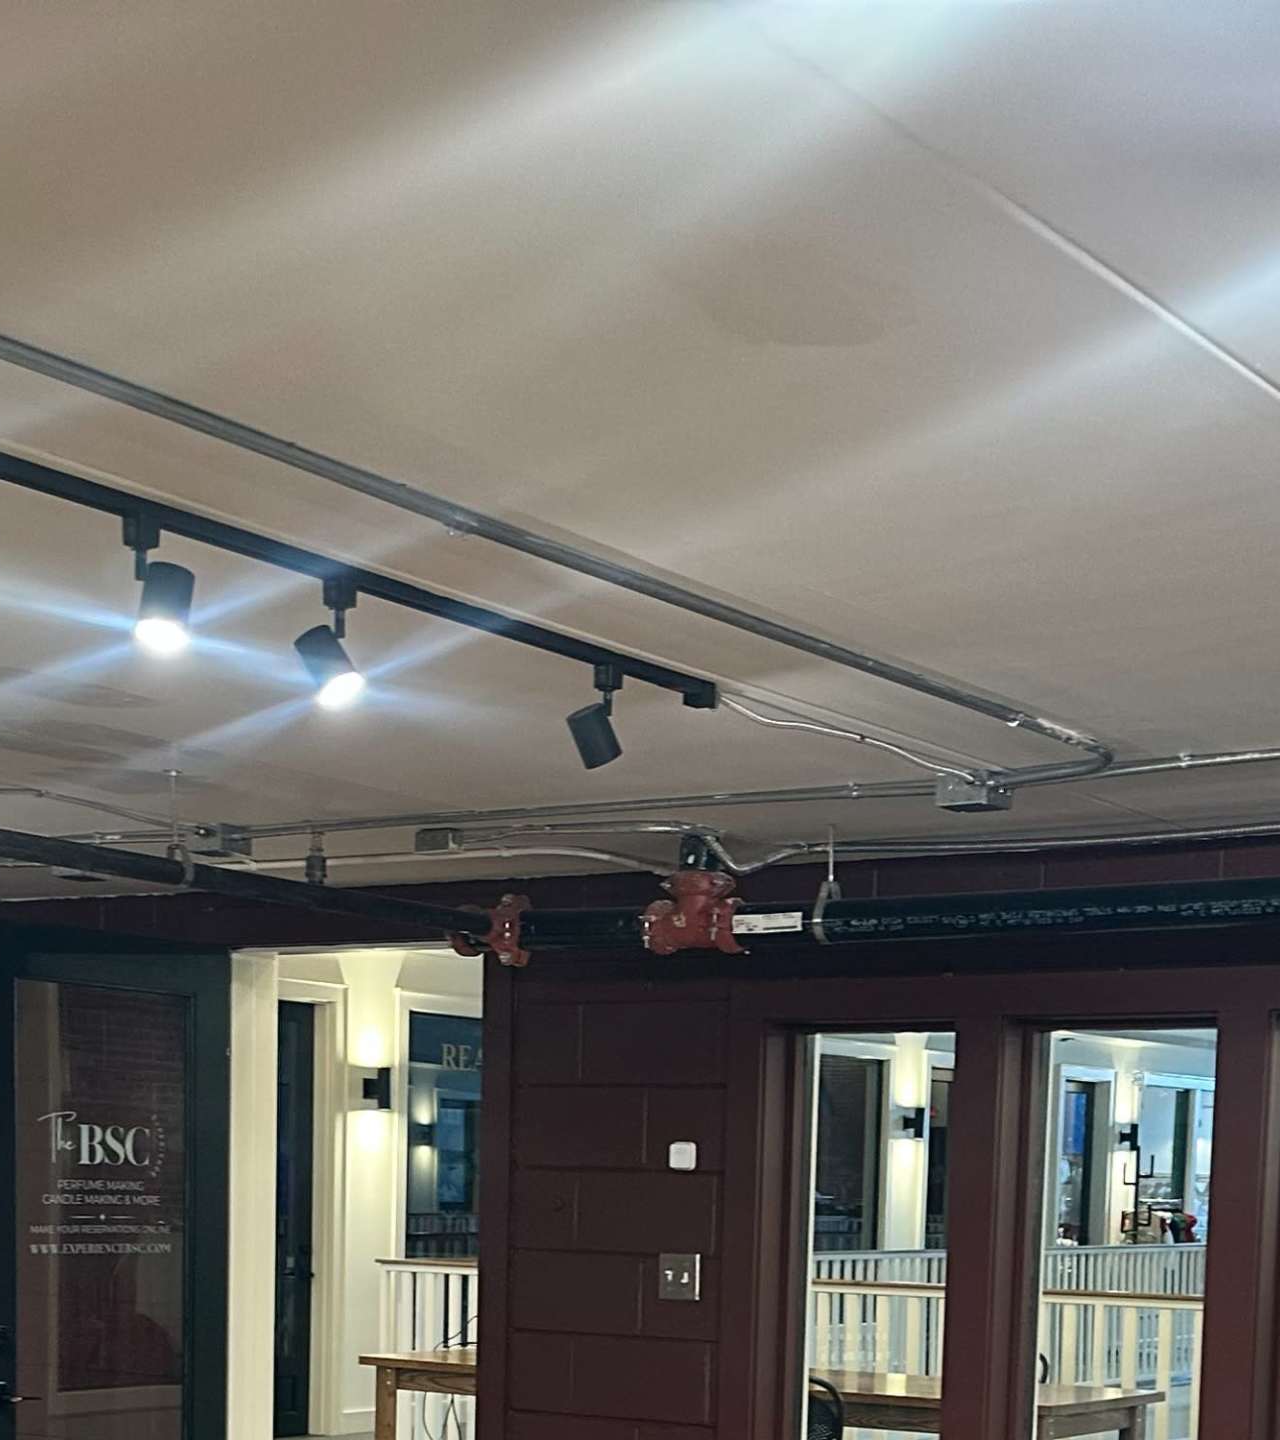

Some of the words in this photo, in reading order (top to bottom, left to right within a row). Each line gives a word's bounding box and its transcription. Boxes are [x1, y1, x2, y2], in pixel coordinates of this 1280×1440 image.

[37, 1111, 77, 1163] The
[78, 1123, 150, 1166] BSC
[56, 1179, 104, 1191] PERFUME
[106, 1180, 145, 1191] MAKING
[41, 1193, 83, 1205] CANDLE
[85, 1194, 125, 1205] MAKING
[133, 1195, 161, 1206] MORE
